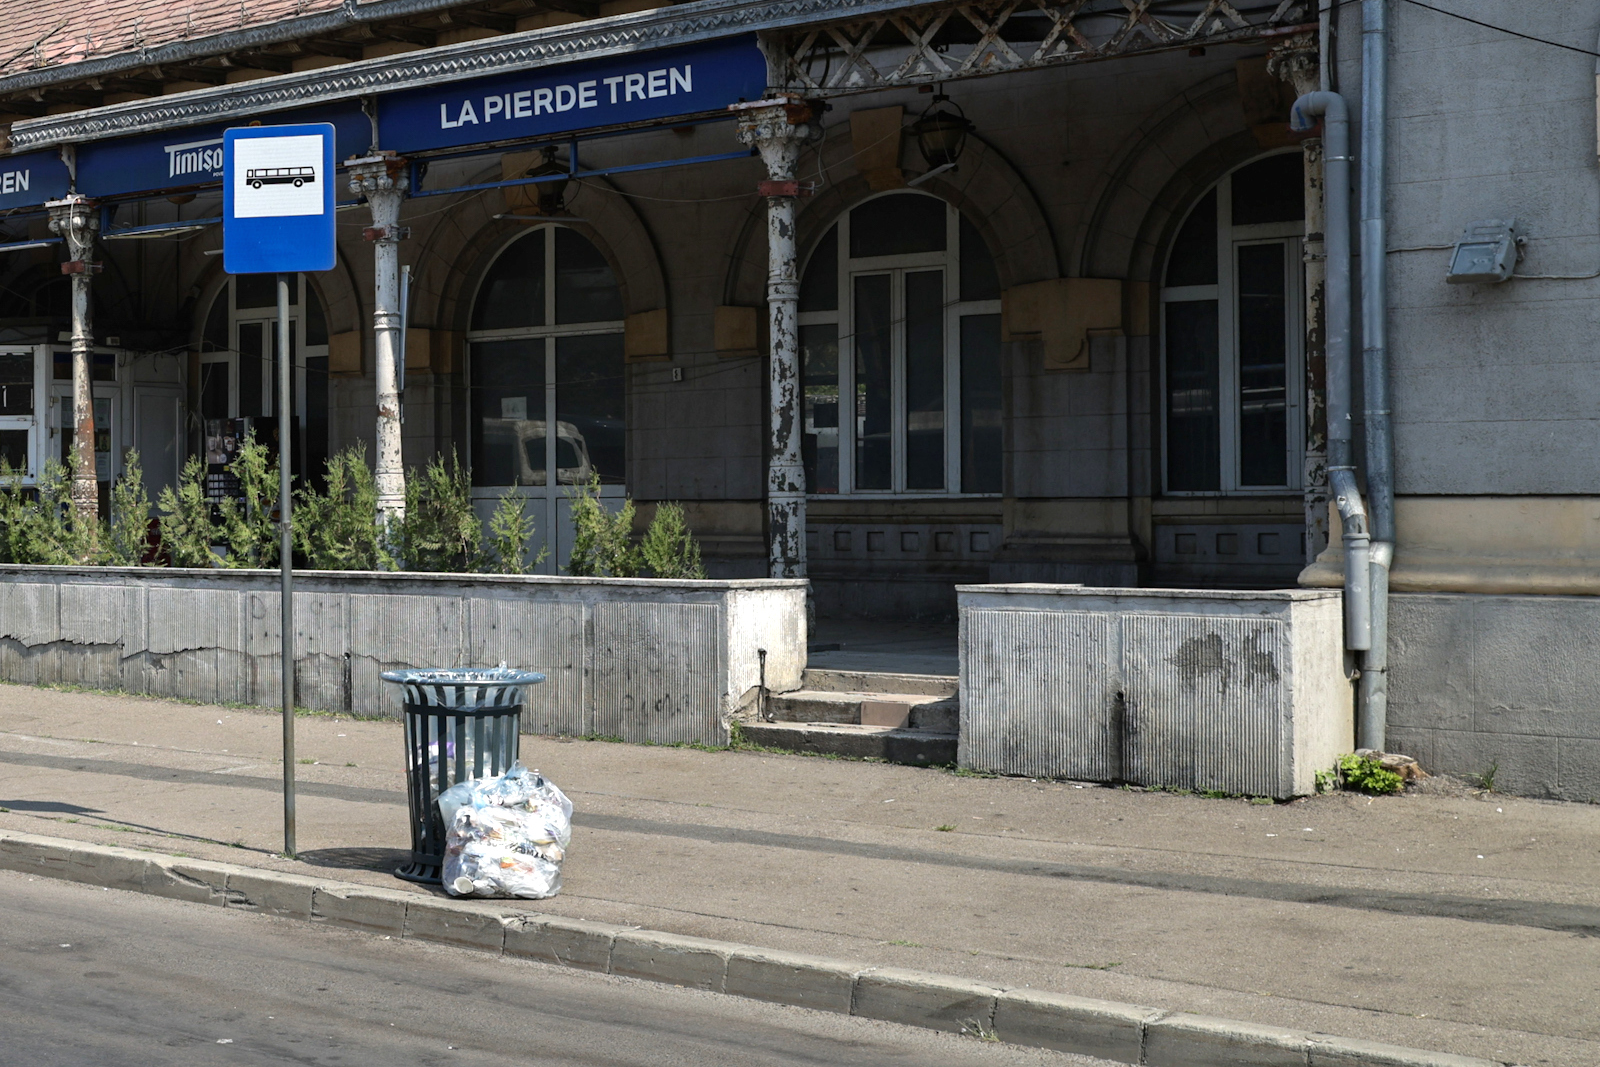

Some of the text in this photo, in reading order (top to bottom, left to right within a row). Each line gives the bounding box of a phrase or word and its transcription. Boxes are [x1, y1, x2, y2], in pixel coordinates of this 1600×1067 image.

[440, 64, 693, 129] LA PIERDE TREN
[163, 137, 224, 179] Timișo
